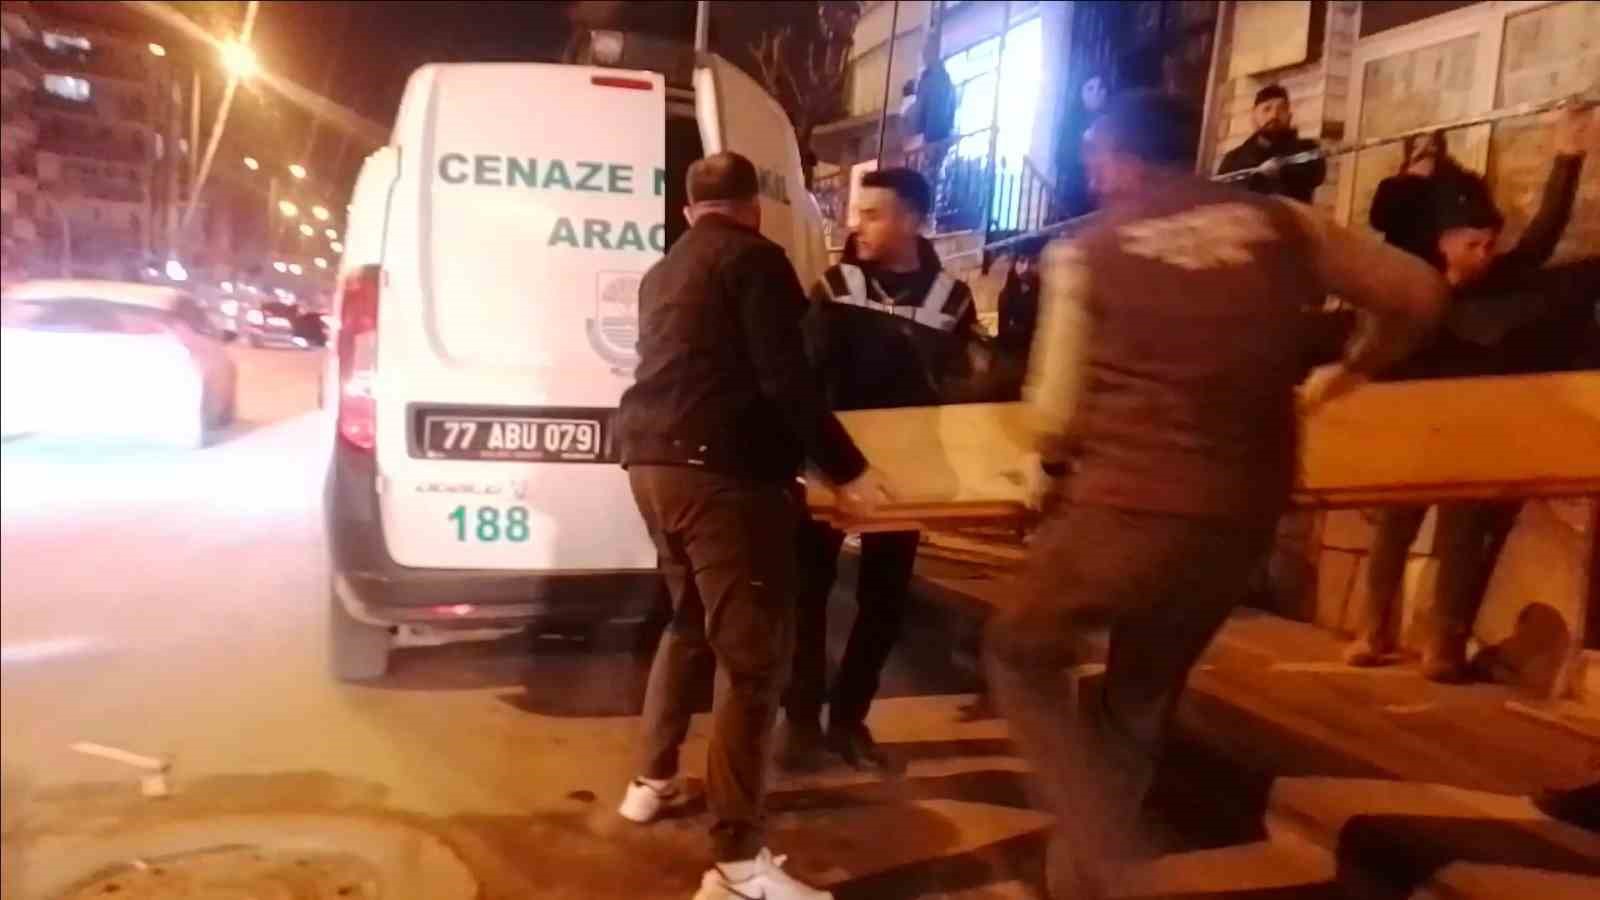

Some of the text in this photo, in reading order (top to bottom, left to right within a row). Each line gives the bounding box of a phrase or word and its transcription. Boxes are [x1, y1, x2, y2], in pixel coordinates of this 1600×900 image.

[438, 153, 634, 194] CENAZE
[443, 421, 593, 452] 77 ABU 079
[449, 505, 530, 542] 188
